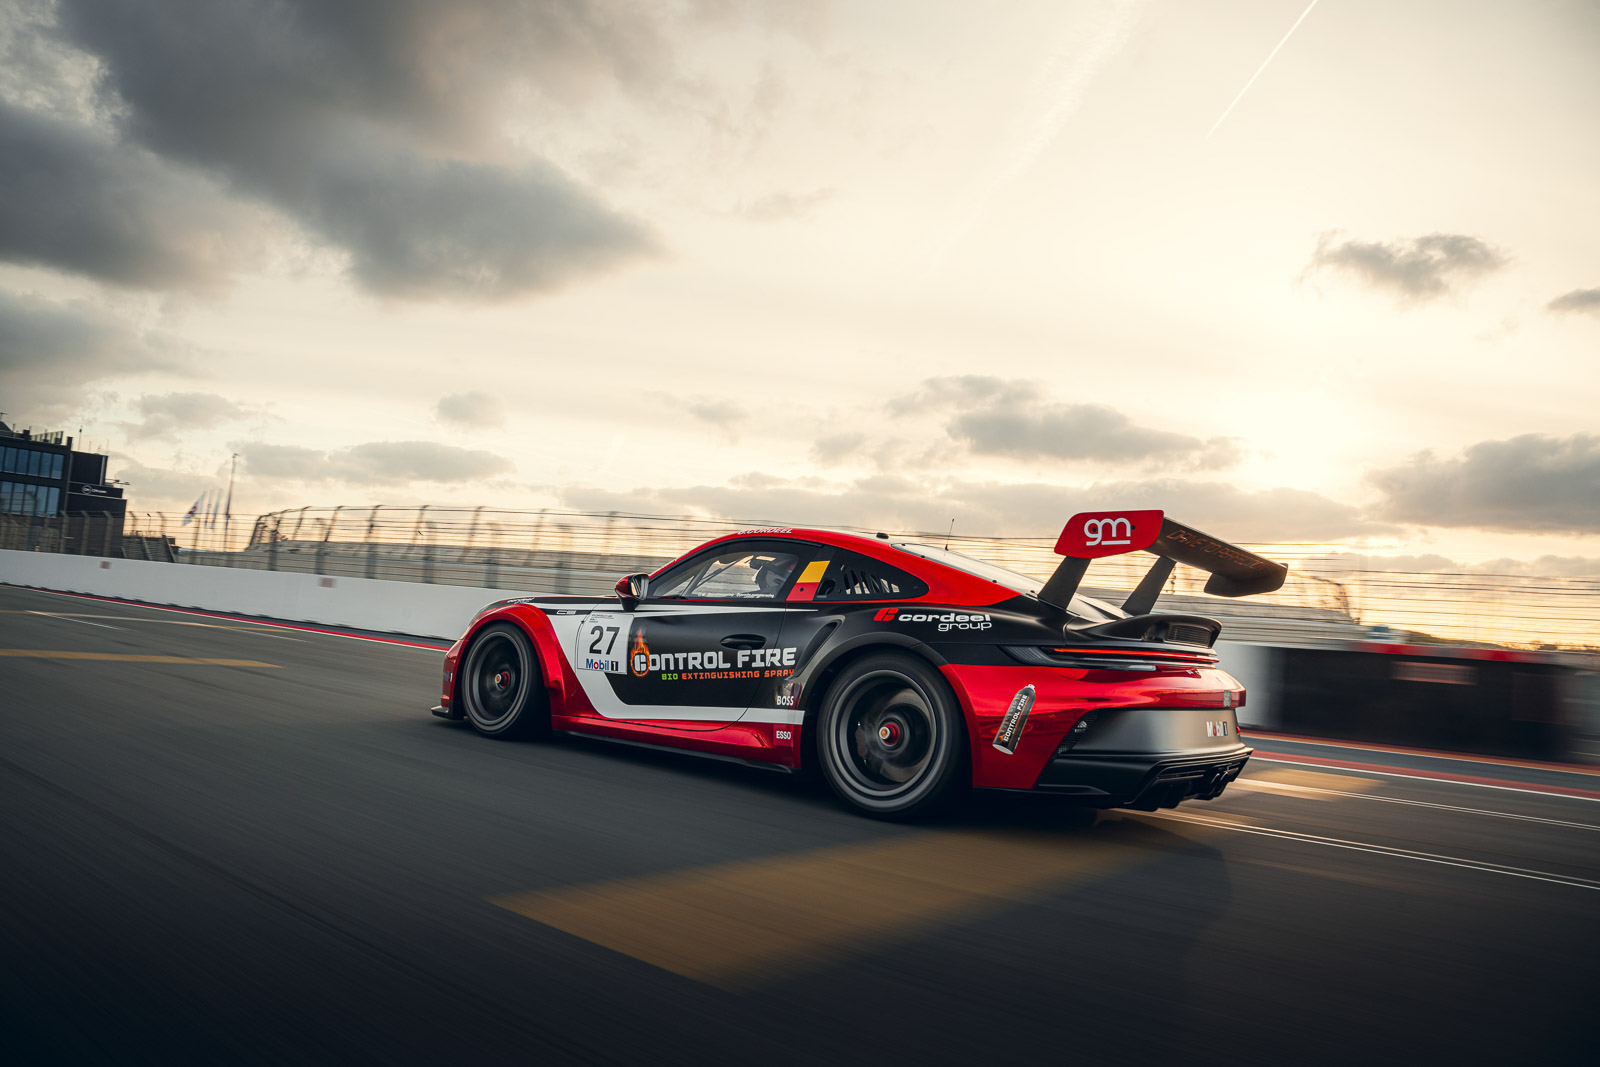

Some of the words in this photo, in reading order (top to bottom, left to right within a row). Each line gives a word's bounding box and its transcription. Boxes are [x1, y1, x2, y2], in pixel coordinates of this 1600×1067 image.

[1083, 517, 1131, 546] gm
[898, 612, 991, 623] cordeel
[937, 622, 993, 632] group
[588, 625, 621, 655] 27
[585, 658, 610, 671] Mobil
[611, 661, 618, 671] 1
[634, 651, 731, 672] CONTROL
[737, 647, 797, 668] FIRE
[661, 673, 679, 681] BIO
[681, 670, 760, 680] EXTINGUISHING
[764, 668, 795, 678] SPRAY
[776, 695, 794, 706] BOSS
[1003, 711, 1021, 742] CONTROL
[1016, 694, 1028, 711] FIRE
[775, 730, 792, 740] ESSO
[1206, 721, 1223, 737] Mobil
